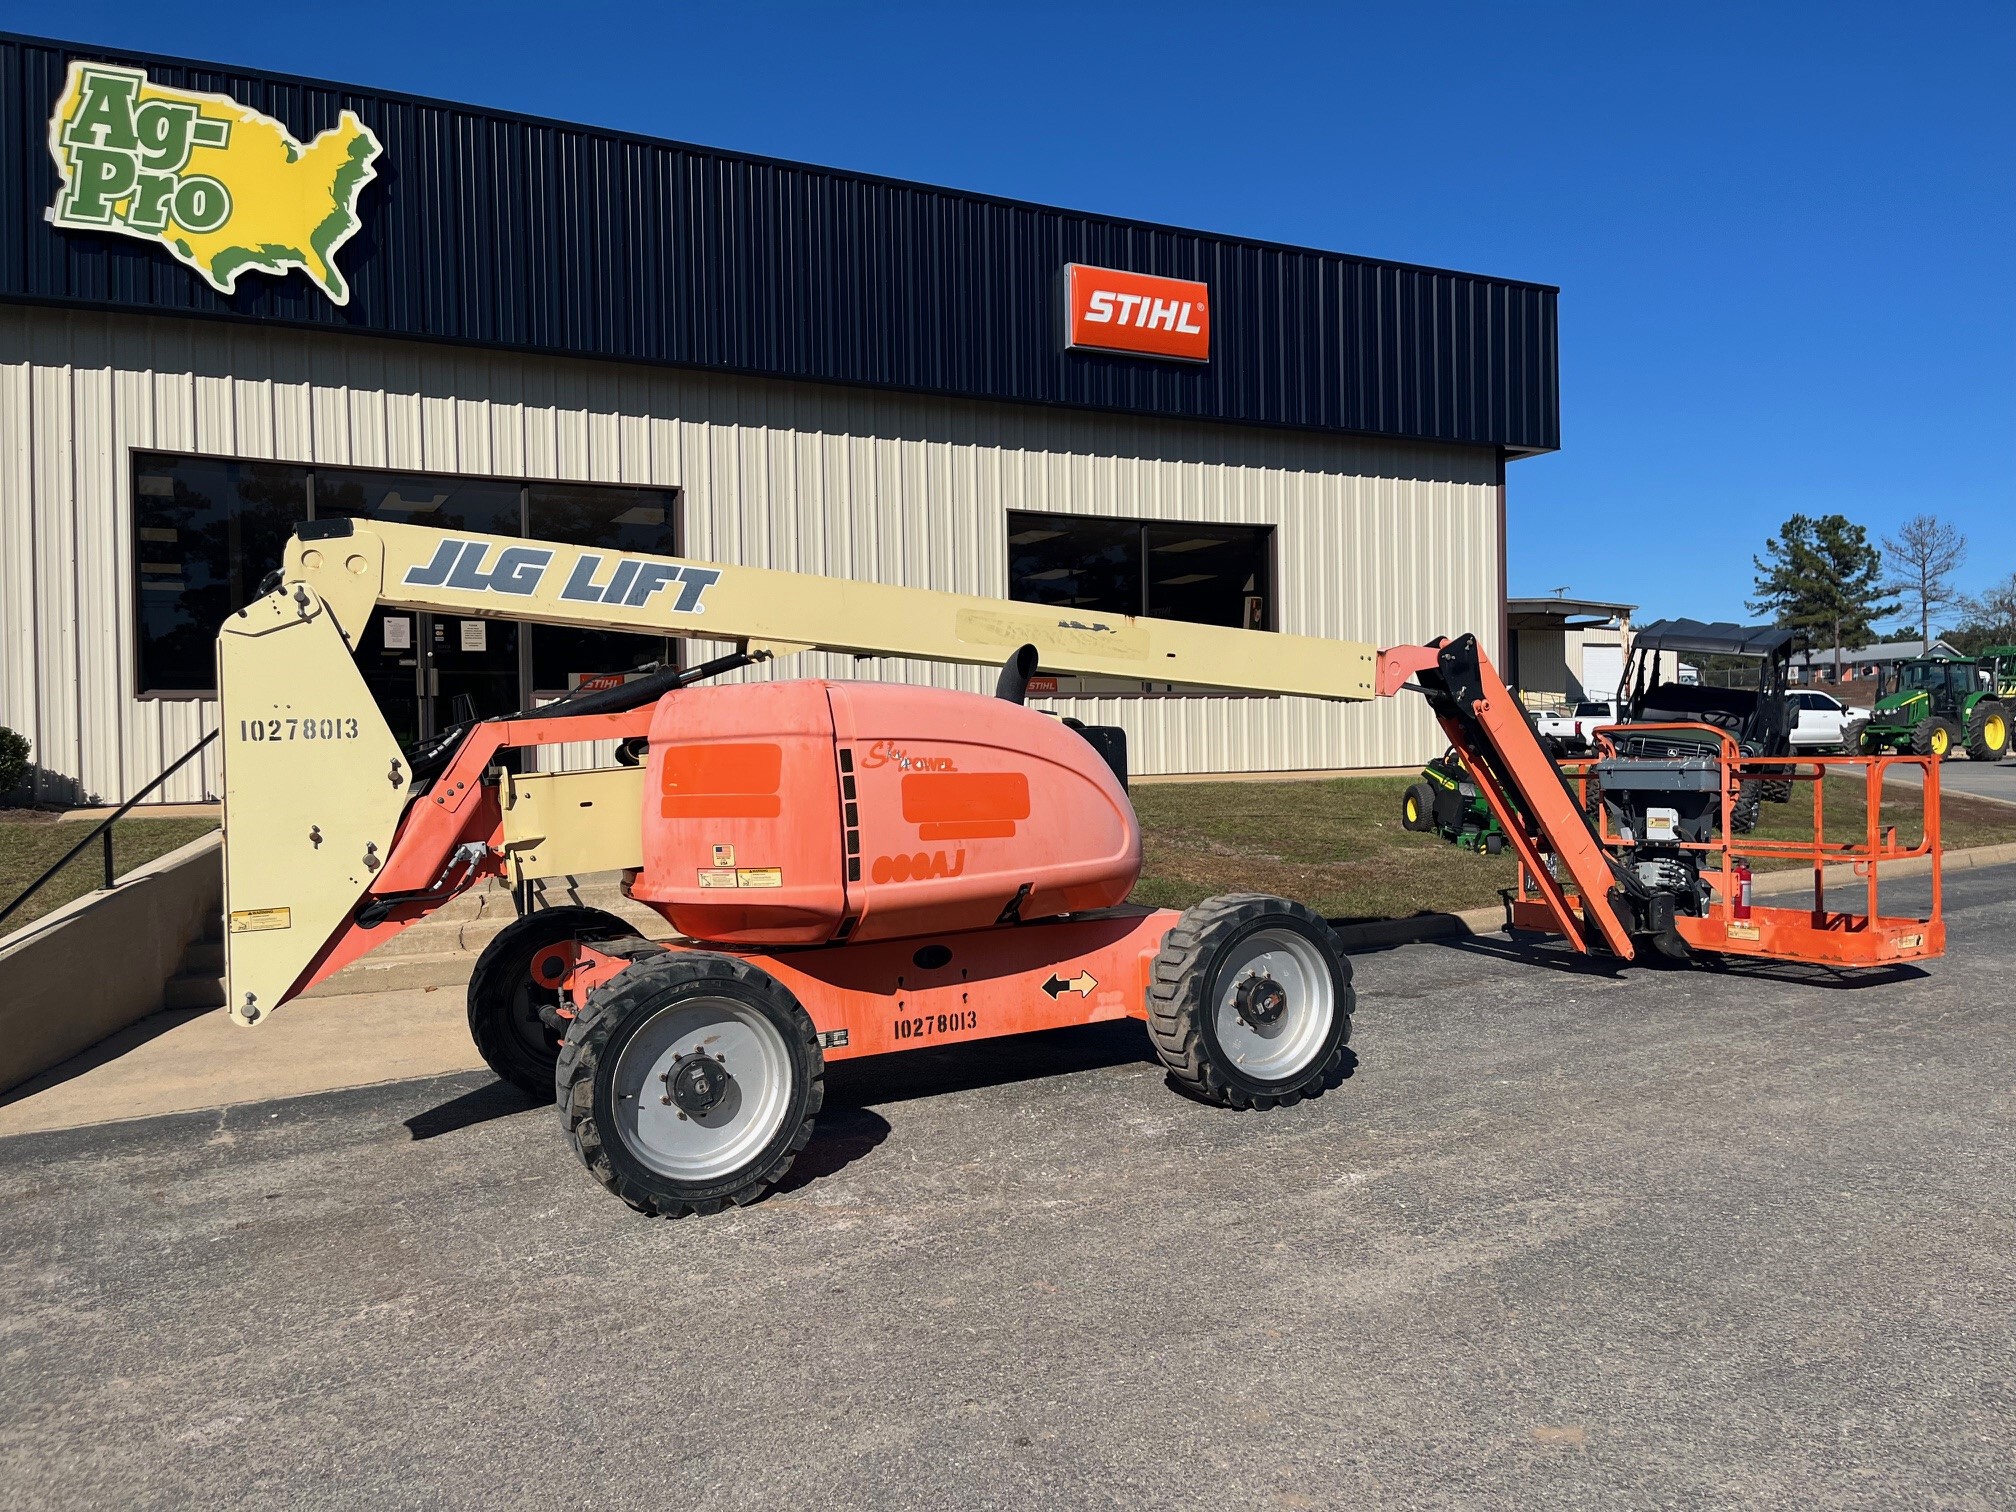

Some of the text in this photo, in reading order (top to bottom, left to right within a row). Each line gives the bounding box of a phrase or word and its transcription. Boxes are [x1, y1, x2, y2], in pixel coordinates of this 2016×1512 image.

[61, 70, 231, 174] Ag-
[62, 147, 232, 233] Pro
[1084, 290, 1200, 334] STIHL
[401, 538, 723, 614] JLG LIFT
[1028, 681, 1056, 690] STIHL
[241, 718, 359, 741] 10278013
[894, 1010, 977, 1040] 10278013
